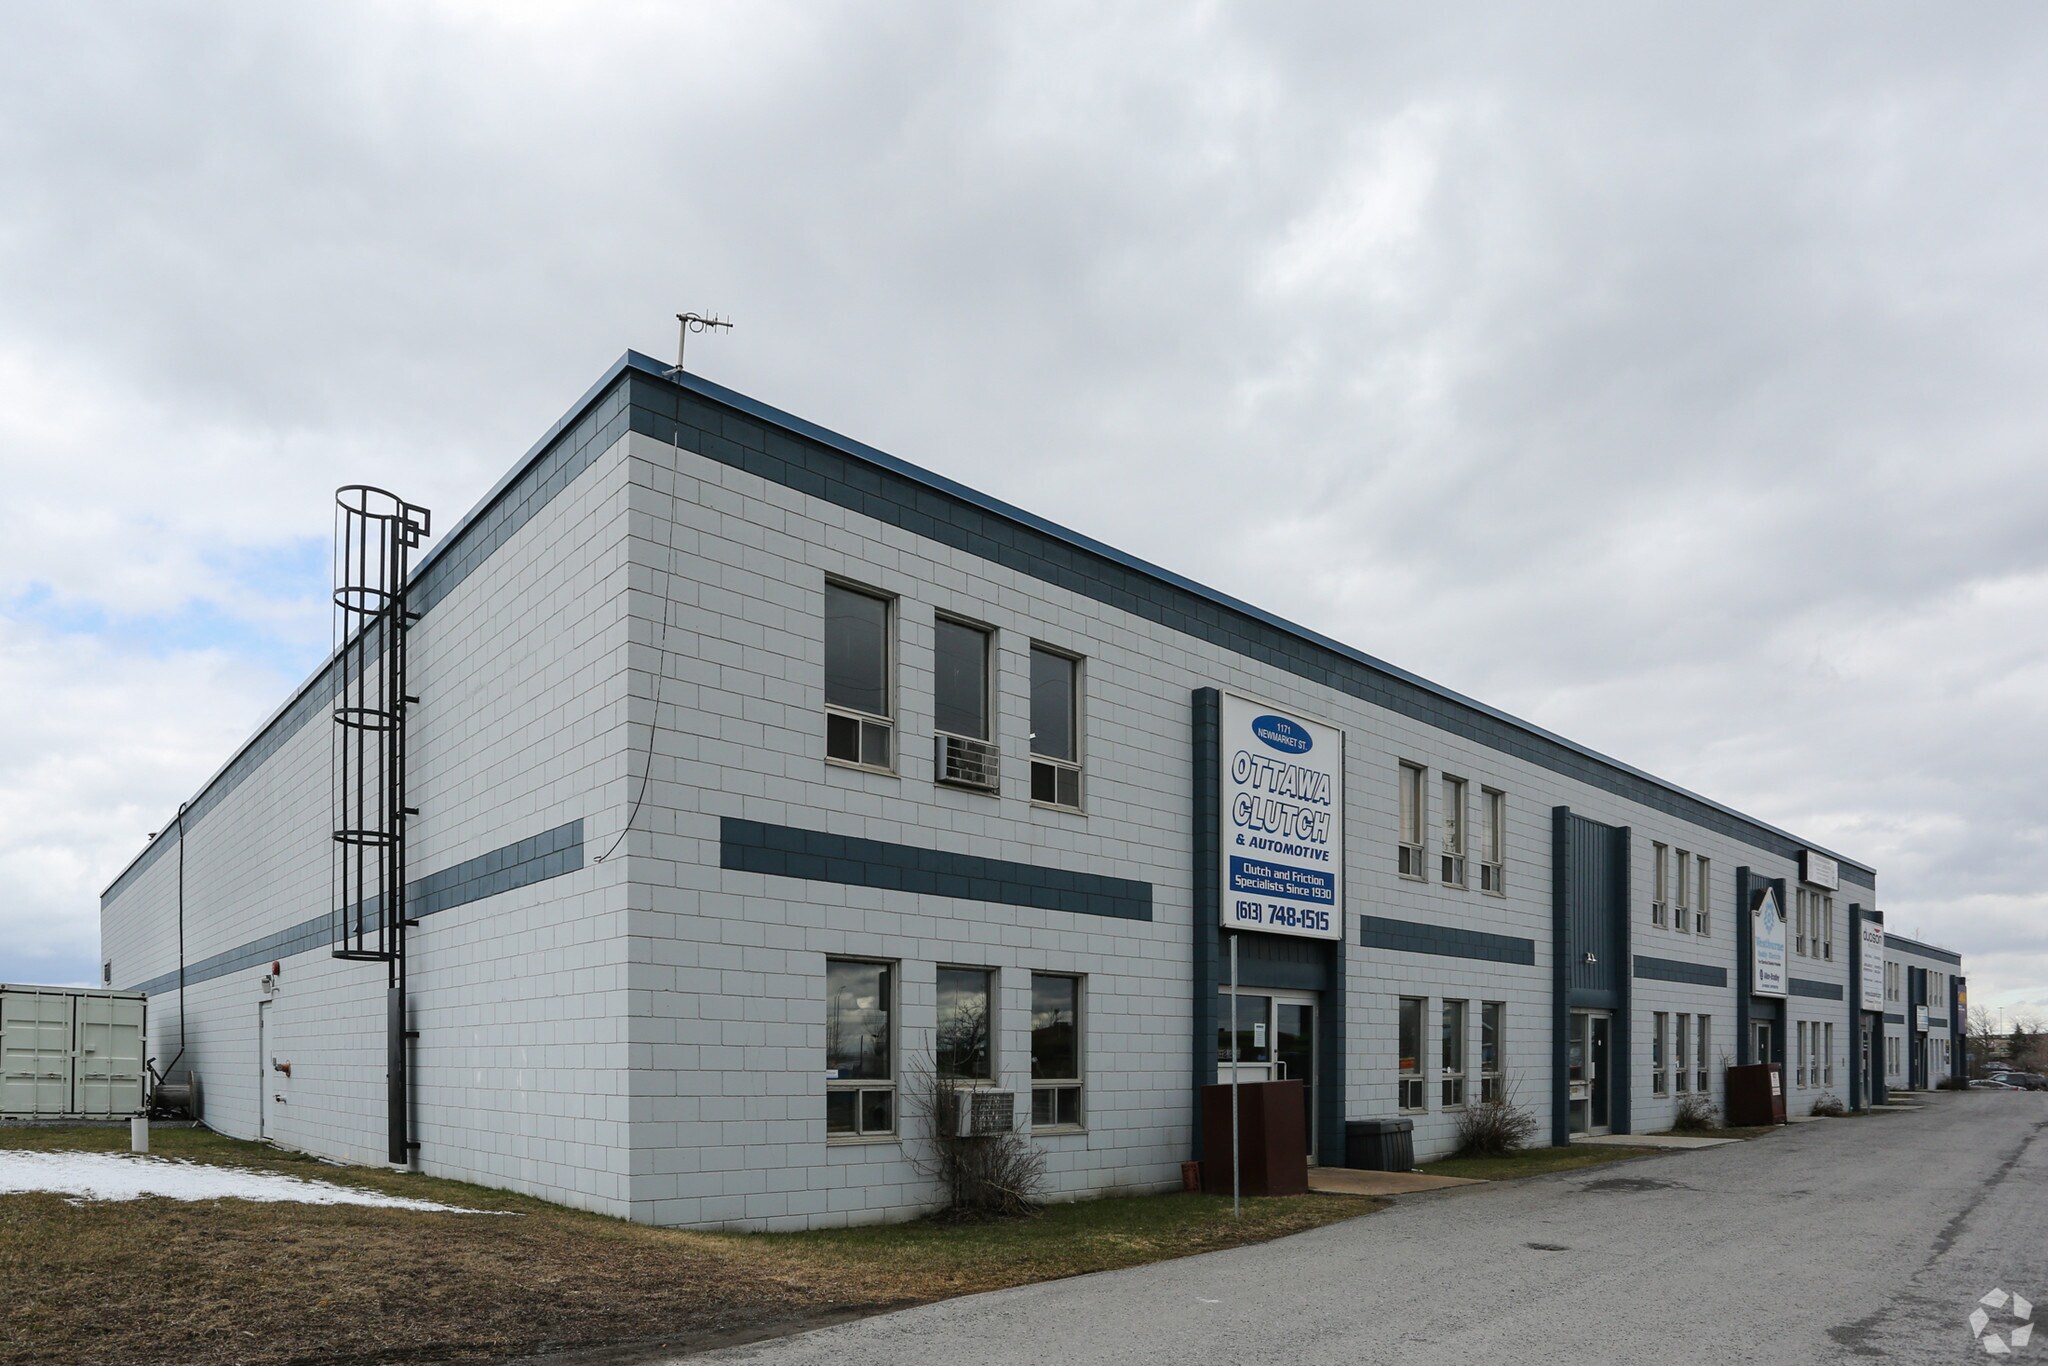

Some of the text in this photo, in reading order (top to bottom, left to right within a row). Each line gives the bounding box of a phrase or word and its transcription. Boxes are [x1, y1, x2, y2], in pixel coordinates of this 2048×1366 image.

[1258, 727, 1308, 751] NEWMARKET ST.
[1277, 723, 1291, 735] 1171
[1232, 750, 1331, 806] OTTAWA
[1232, 792, 1331, 845] CLUTCH
[1236, 833, 1330, 861] & AUTOMOTIVE
[1235, 874, 1332, 900] Specialists Since 1930
[1243, 862, 1325, 886] Clutch and Friction
[1236, 900, 1329, 931] (613) 748-1515
